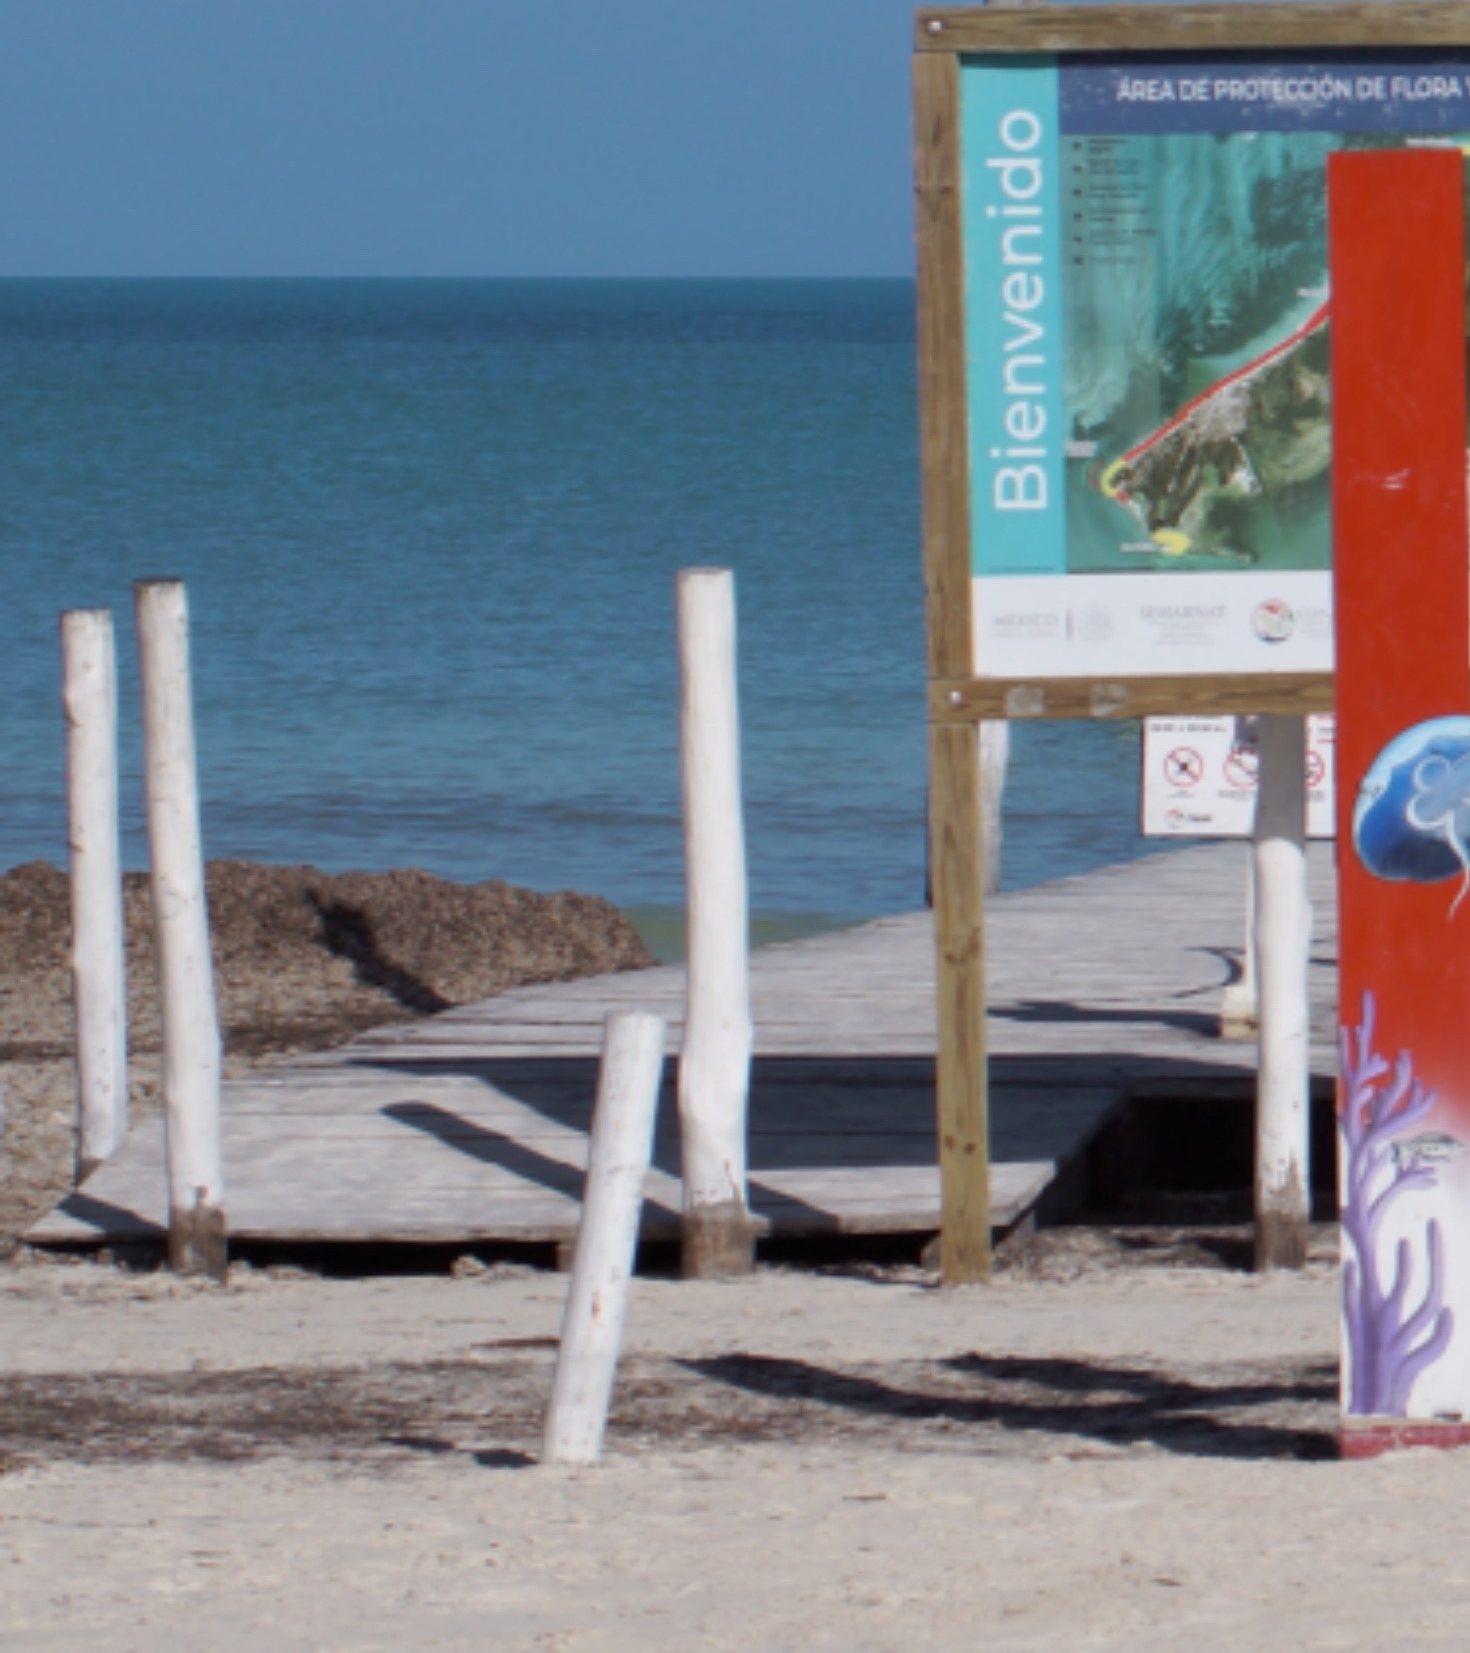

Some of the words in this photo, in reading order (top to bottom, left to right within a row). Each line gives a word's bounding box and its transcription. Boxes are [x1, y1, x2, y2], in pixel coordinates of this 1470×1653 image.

[1116, 74, 1175, 102] ÁREA
[1179, 77, 1211, 101] DE
[1213, 73, 1352, 102] PROTECCIÓN
[1356, 75, 1388, 99] DE
[1391, 75, 1462, 100] FLORA
[985, 108, 1049, 511] Bienvenido
